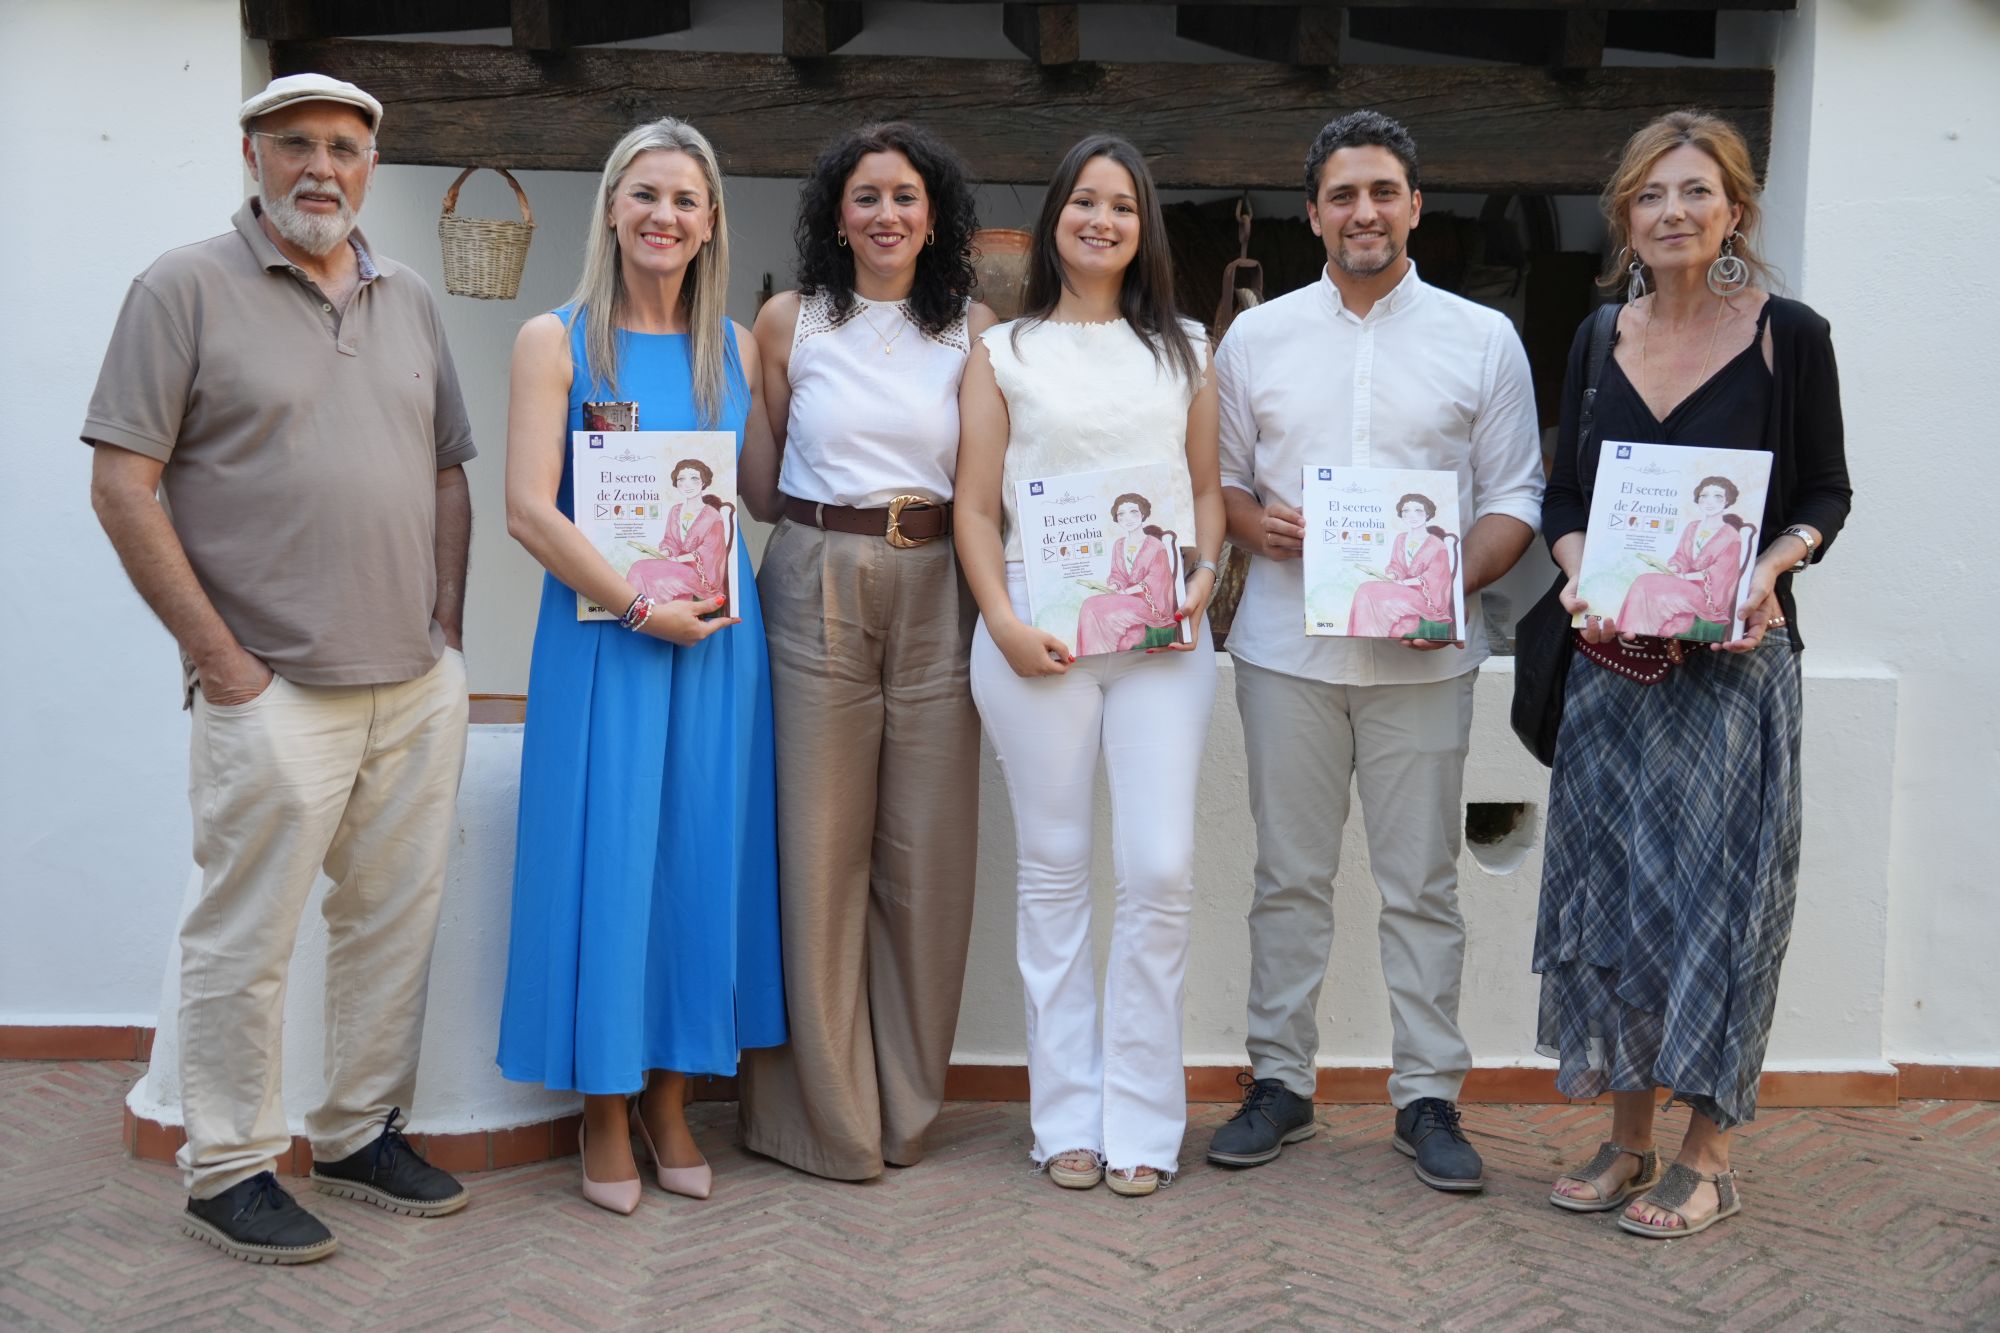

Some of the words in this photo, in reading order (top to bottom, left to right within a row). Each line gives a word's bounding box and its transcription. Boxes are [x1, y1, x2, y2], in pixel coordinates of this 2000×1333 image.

[601, 471, 612, 483] El
[615, 474, 656, 483] secreto
[597, 489, 611, 501] de
[613, 489, 660, 501] Zenobia
[1620, 481, 1634, 494] El
[1635, 486, 1678, 497] secreto
[1328, 500, 1340, 511] El
[1342, 504, 1382, 513] secreto
[1614, 499, 1628, 511] de
[1630, 500, 1679, 516] Zenobia
[1043, 515, 1055, 527] El
[1057, 513, 1097, 525] secreto
[1325, 517, 1338, 527] de
[1341, 517, 1385, 529] Zenobia
[1042, 533, 1056, 545] de
[1058, 527, 1103, 543] Zenobia
